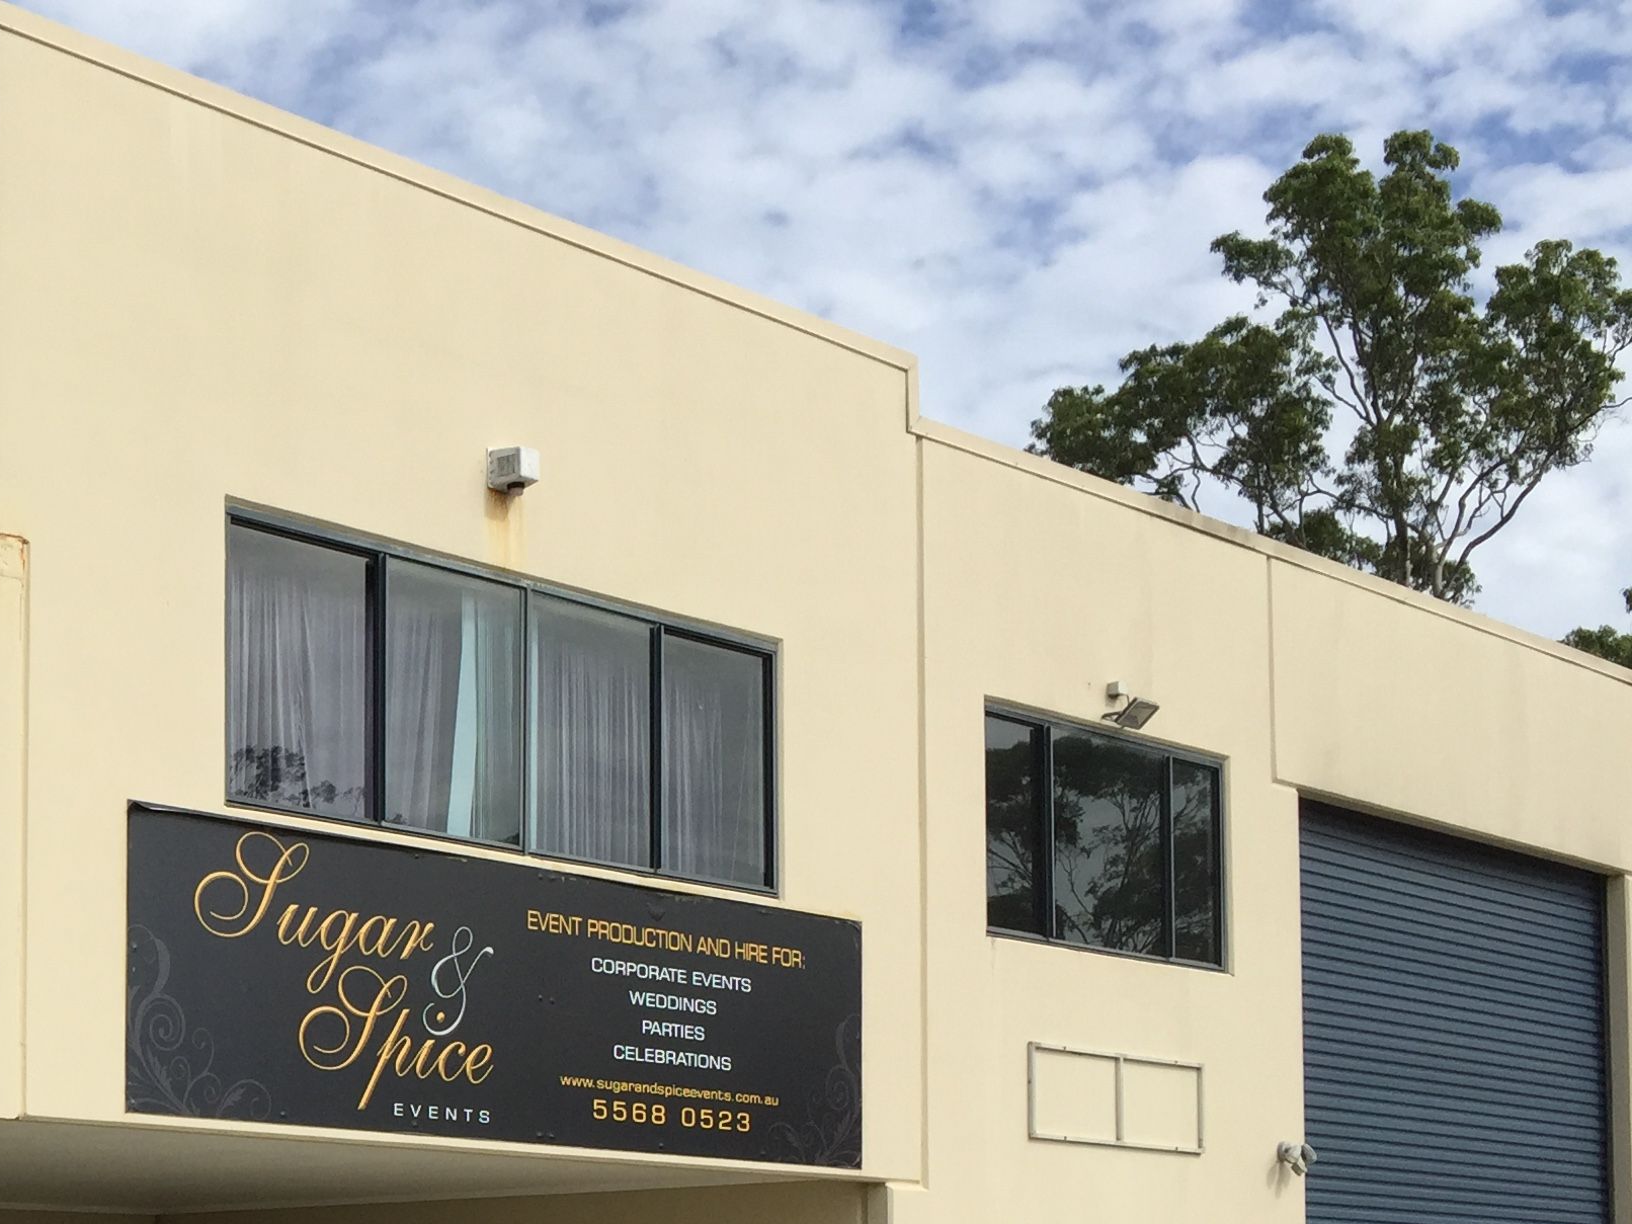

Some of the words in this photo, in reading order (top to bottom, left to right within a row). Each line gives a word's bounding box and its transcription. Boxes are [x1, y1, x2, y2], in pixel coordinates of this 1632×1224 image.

[194, 831, 435, 994] Sugar
[422, 926, 494, 1036] &
[527, 909, 583, 937] EVENT
[587, 918, 693, 954] PRODUCTION
[697, 936, 731, 959] AND
[735, 941, 768, 965] HIRE
[772, 947, 806, 970] FOR:
[591, 956, 687, 985] CORPORATE
[692, 971, 752, 993] EVENTS
[629, 990, 717, 1015] WEDDINGS
[299, 965, 494, 1110] Spice
[642, 1020, 706, 1042] PARTIES
[613, 1044, 732, 1071] CELEBRATIONS
[559, 1075, 780, 1107] www.sugarandspiceevents.com.au
[393, 1102, 491, 1124] EVENTS
[592, 1098, 667, 1125] 5568
[681, 1106, 751, 1132] 0523
